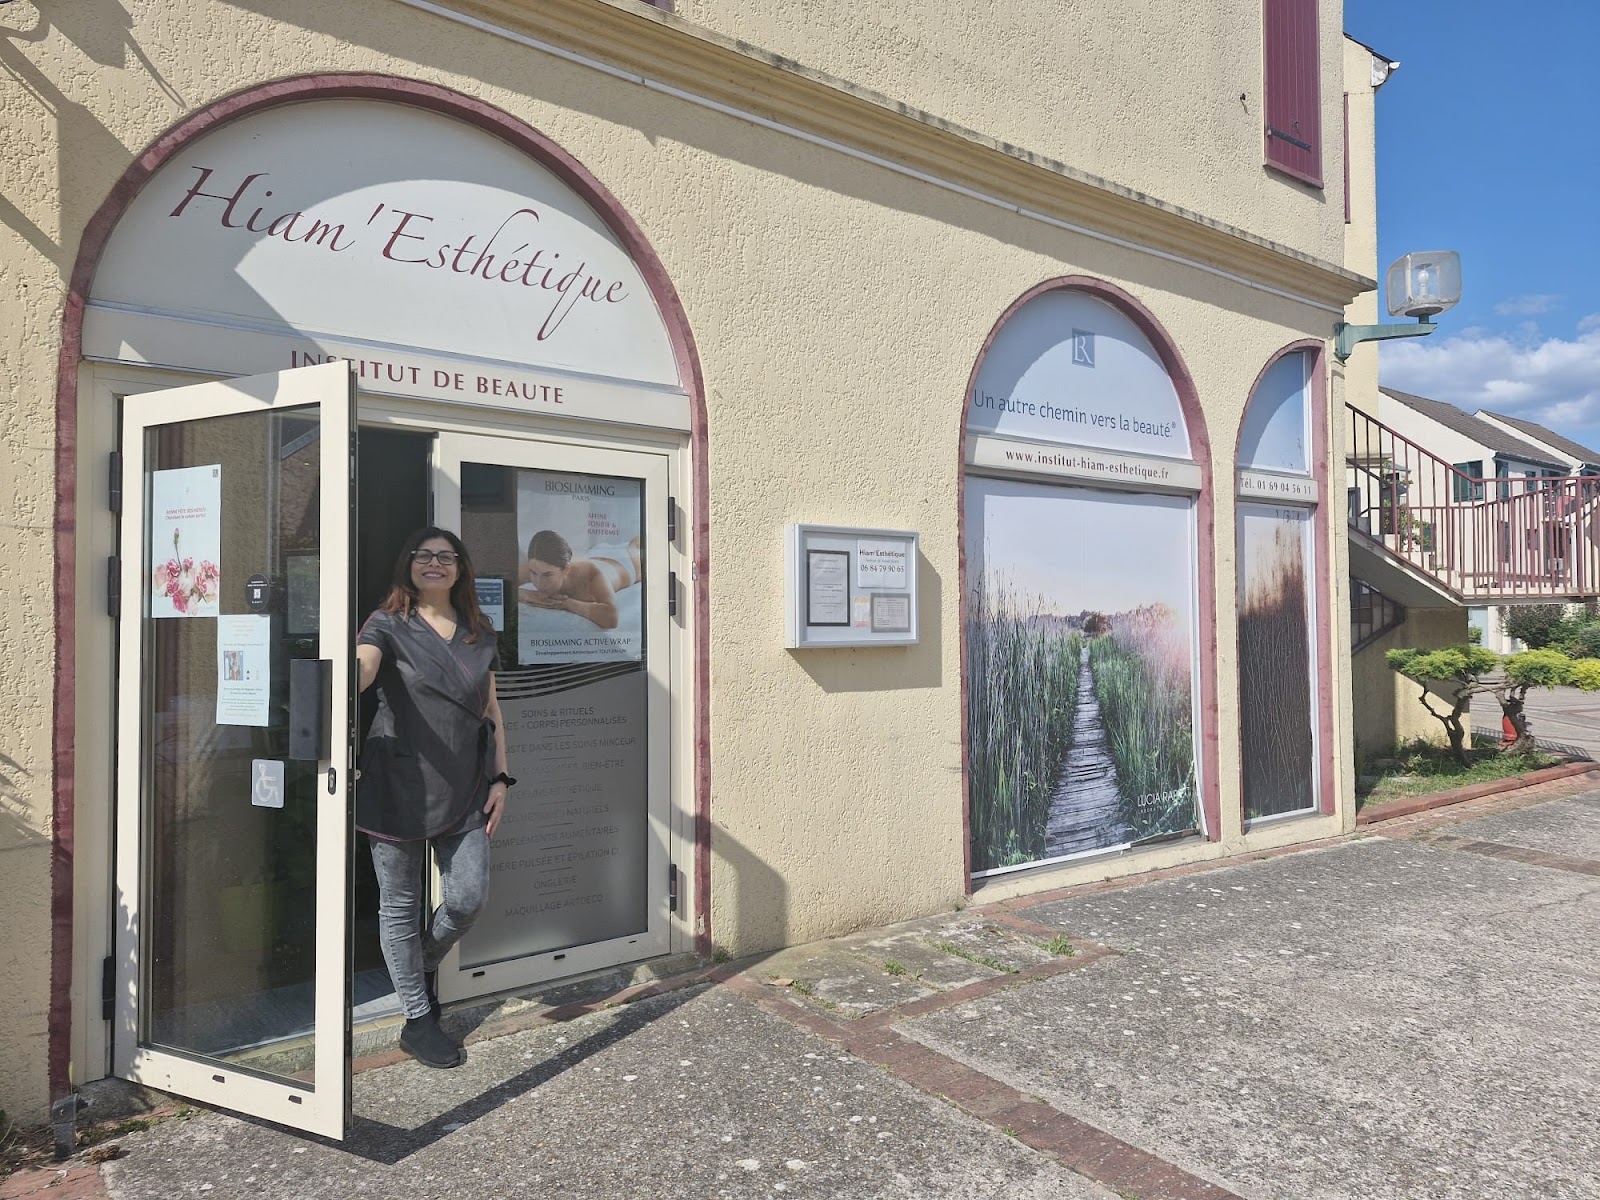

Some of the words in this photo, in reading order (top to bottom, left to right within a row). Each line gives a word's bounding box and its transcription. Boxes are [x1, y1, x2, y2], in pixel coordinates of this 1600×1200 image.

[433, 370, 465, 391] DE
[476, 376, 564, 404] BEAUTE
[974, 388, 995, 409] Un
[998, 397, 1036, 416] autre
[1039, 401, 1087, 424] chemin
[1090, 413, 1117, 429] vers
[1119, 414, 1130, 431] la
[1005, 451, 1169, 480] www.institut-hiam-esthetique.fr
[545, 480, 615, 496] BIOSLIMMING
[1257, 480, 1266, 490] 01
[1269, 481, 1278, 491] 69
[1280, 482, 1289, 492] 04
[1292, 483, 1301, 494] 56
[1303, 485, 1311, 495] 11
[571, 494, 590, 502] PARIS
[530, 638, 582, 647] BIOSLIMMING
[583, 638, 608, 646] ACTIVE
[609, 637, 631, 646] WRAP
[521, 709, 549, 719] SOINS
[550, 709, 557, 718] &
[559, 706, 595, 717] RITUELS
